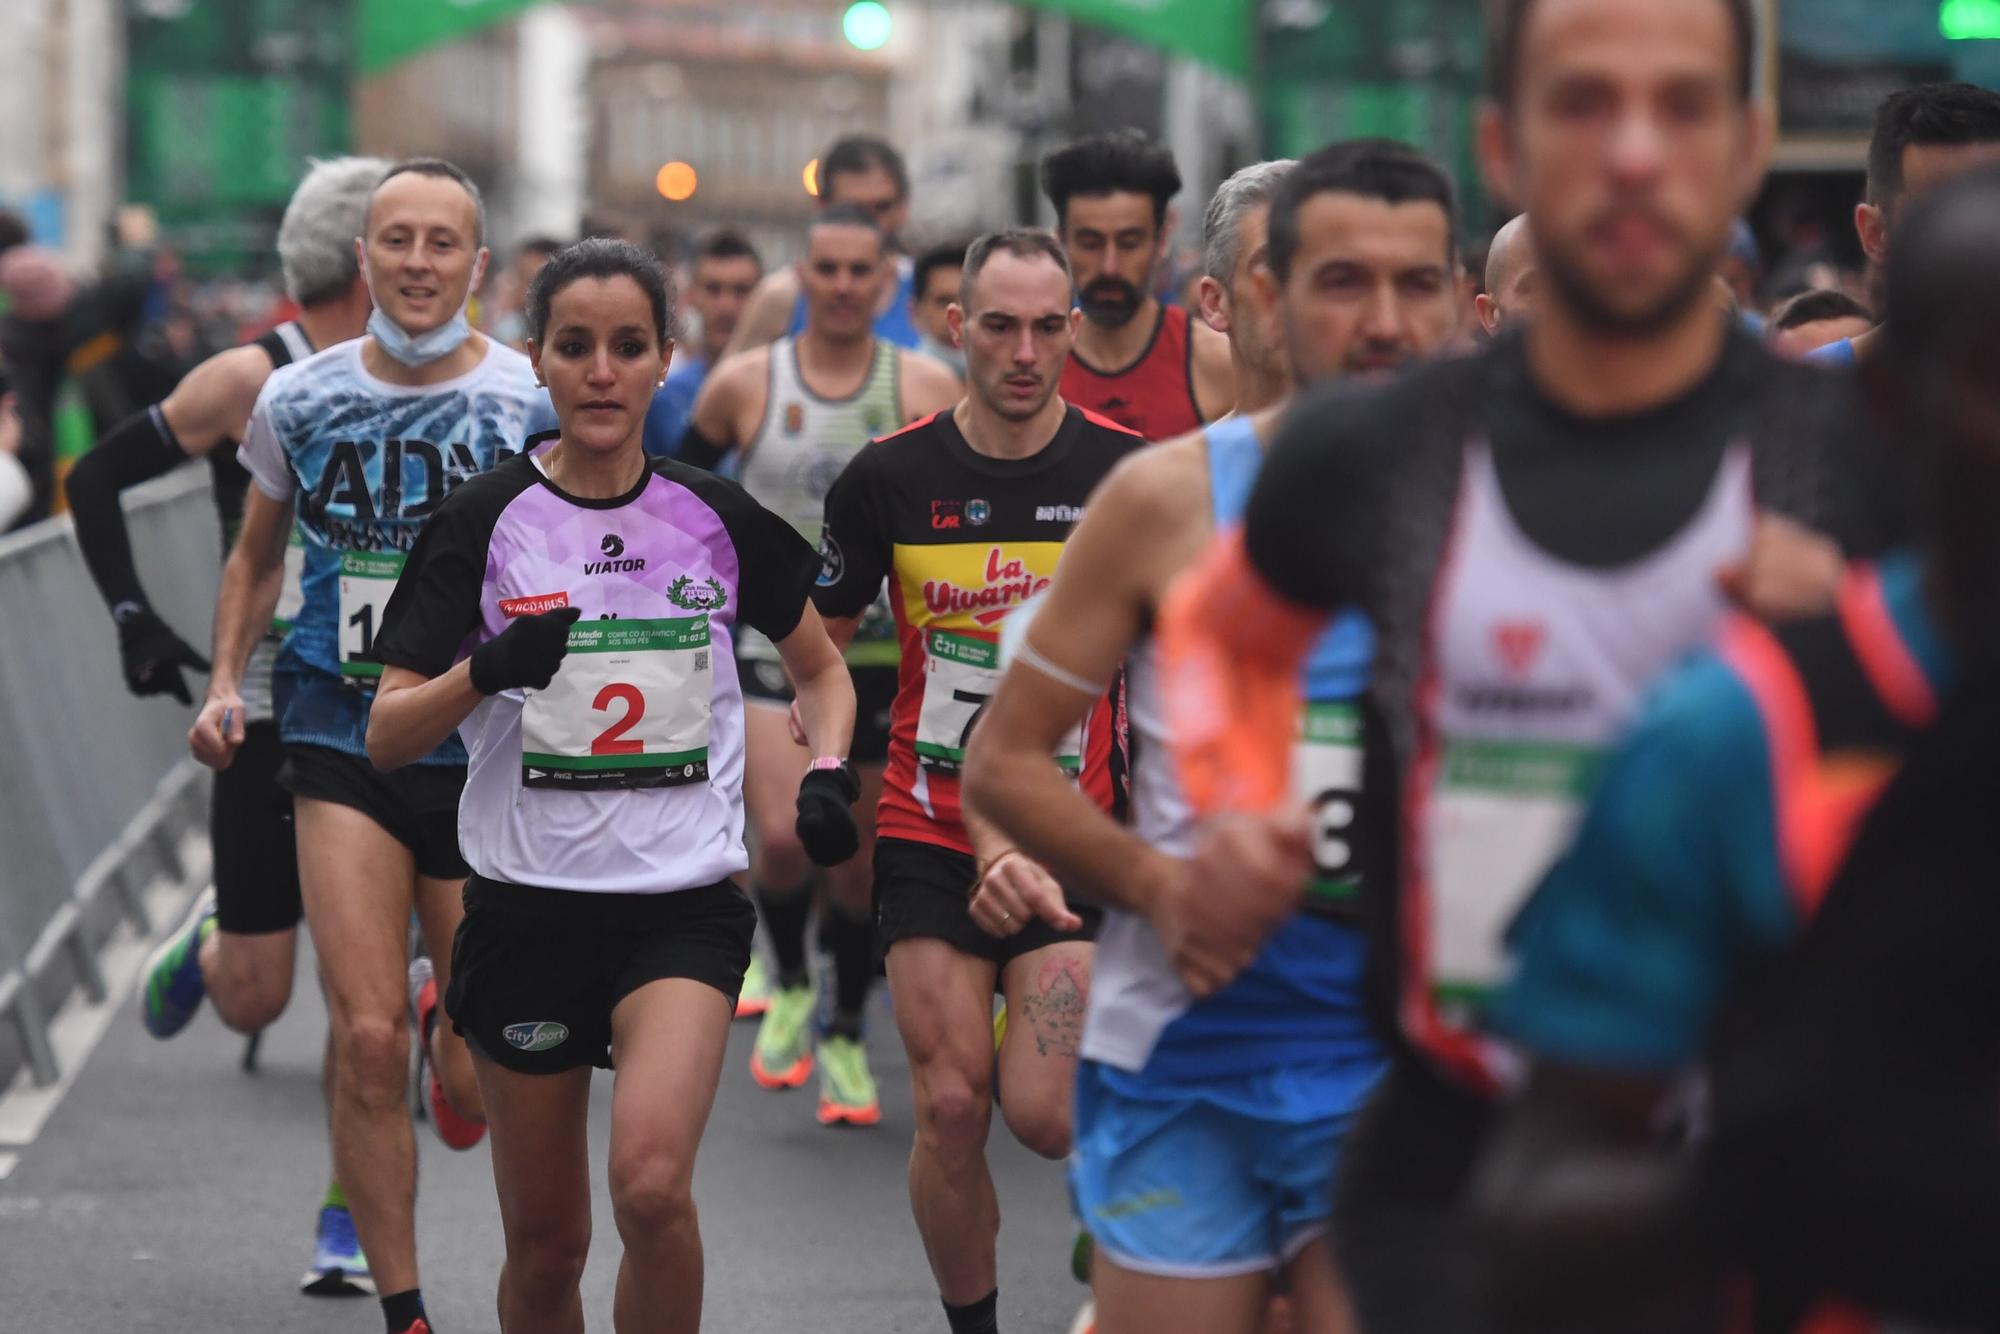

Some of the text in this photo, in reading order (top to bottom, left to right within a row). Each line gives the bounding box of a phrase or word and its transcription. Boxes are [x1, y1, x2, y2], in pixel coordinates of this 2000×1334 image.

[584, 558, 646, 576] VIATOR
[986, 547, 1023, 582] La
[578, 630, 603, 640] Media
[591, 683, 646, 755] 2
